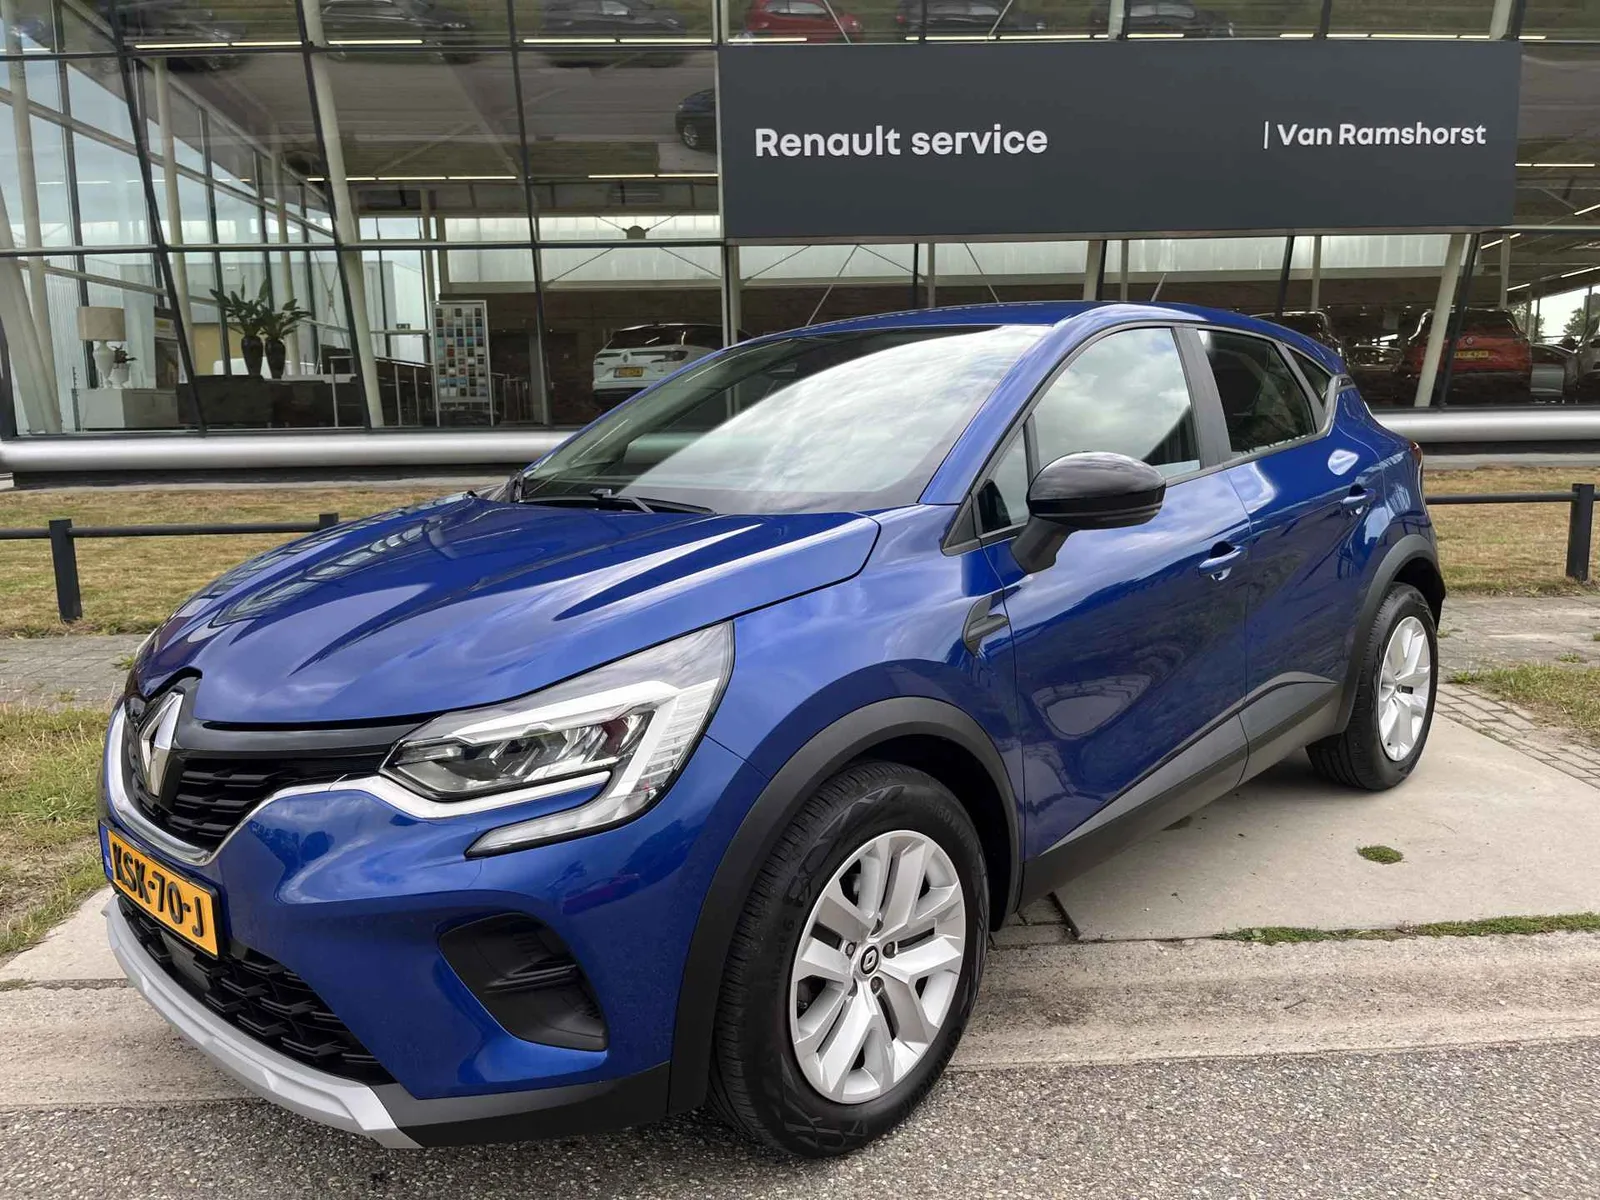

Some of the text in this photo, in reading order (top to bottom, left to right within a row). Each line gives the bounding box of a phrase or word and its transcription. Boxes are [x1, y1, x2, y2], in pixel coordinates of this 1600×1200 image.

[755, 123, 1048, 157] Renault service
[1277, 121, 1487, 146] Van Ramshorst
